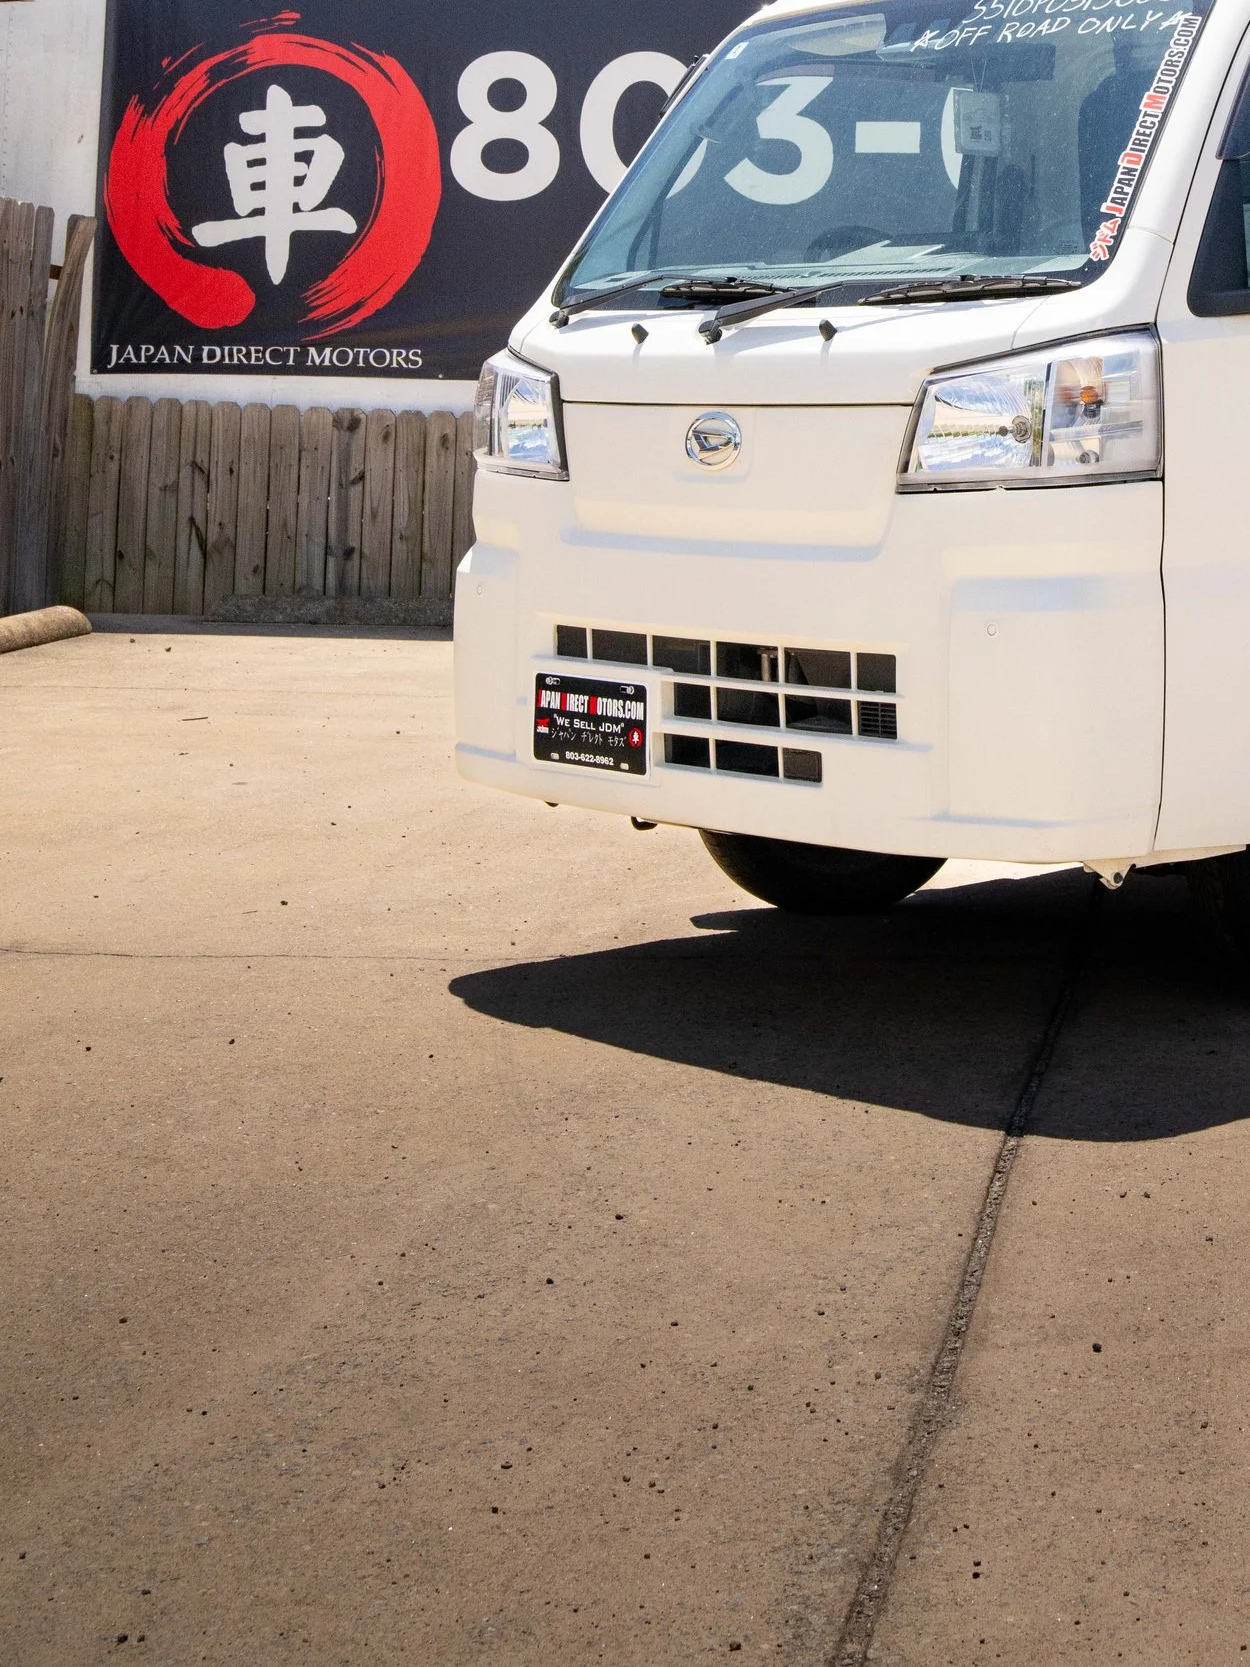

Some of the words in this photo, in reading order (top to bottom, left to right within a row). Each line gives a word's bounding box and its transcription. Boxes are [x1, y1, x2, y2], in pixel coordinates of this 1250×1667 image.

[934, 25, 992, 51] OFF
[996, 16, 1065, 43] ROAD
[1077, 9, 1162, 35] ONLY
[450, 50, 973, 205] 803-
[192, 84, 358, 285] 車
[107, 344, 195, 369] JAPAN
[202, 345, 301, 366] DIRECT
[305, 346, 423, 369] MOTORS
[574, 719, 596, 730] SELL
[566, 752, 614, 765] 803-622-8962
